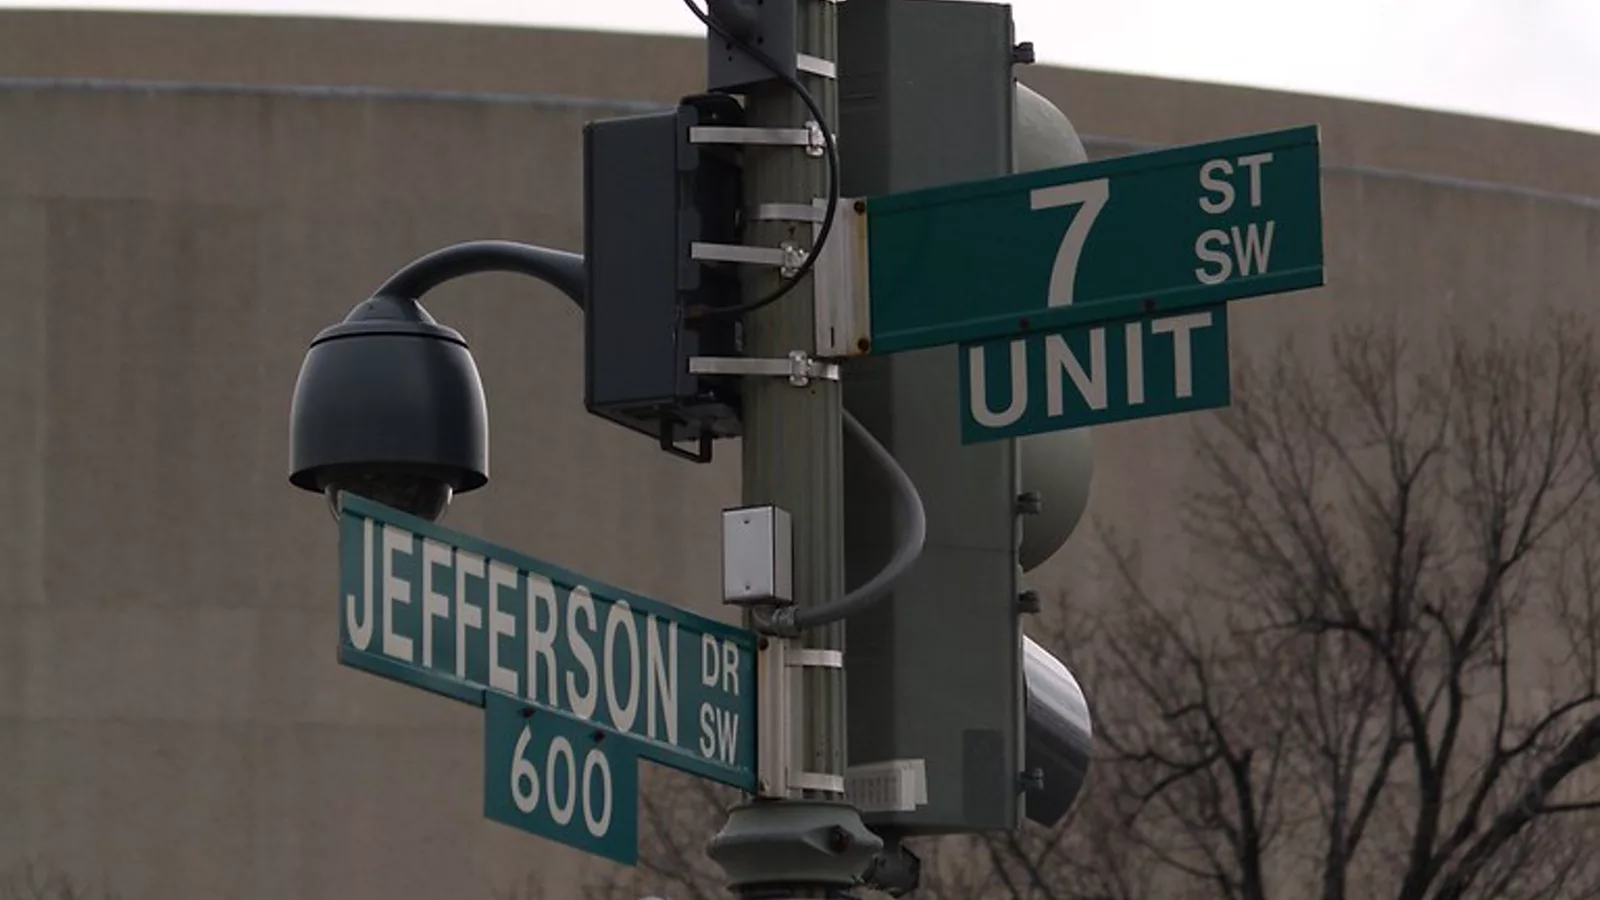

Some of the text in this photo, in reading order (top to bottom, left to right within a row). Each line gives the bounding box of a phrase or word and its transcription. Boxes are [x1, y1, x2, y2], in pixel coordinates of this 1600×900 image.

[1199, 152, 1274, 214] ST
[1030, 178, 1110, 308] 7
[1194, 220, 1275, 285] SW
[969, 312, 1213, 428] UNIT
[345, 518, 678, 746] JEFFERSON
[702, 633, 740, 695] DR
[700, 703, 738, 764] SW
[511, 724, 612, 837] 600
